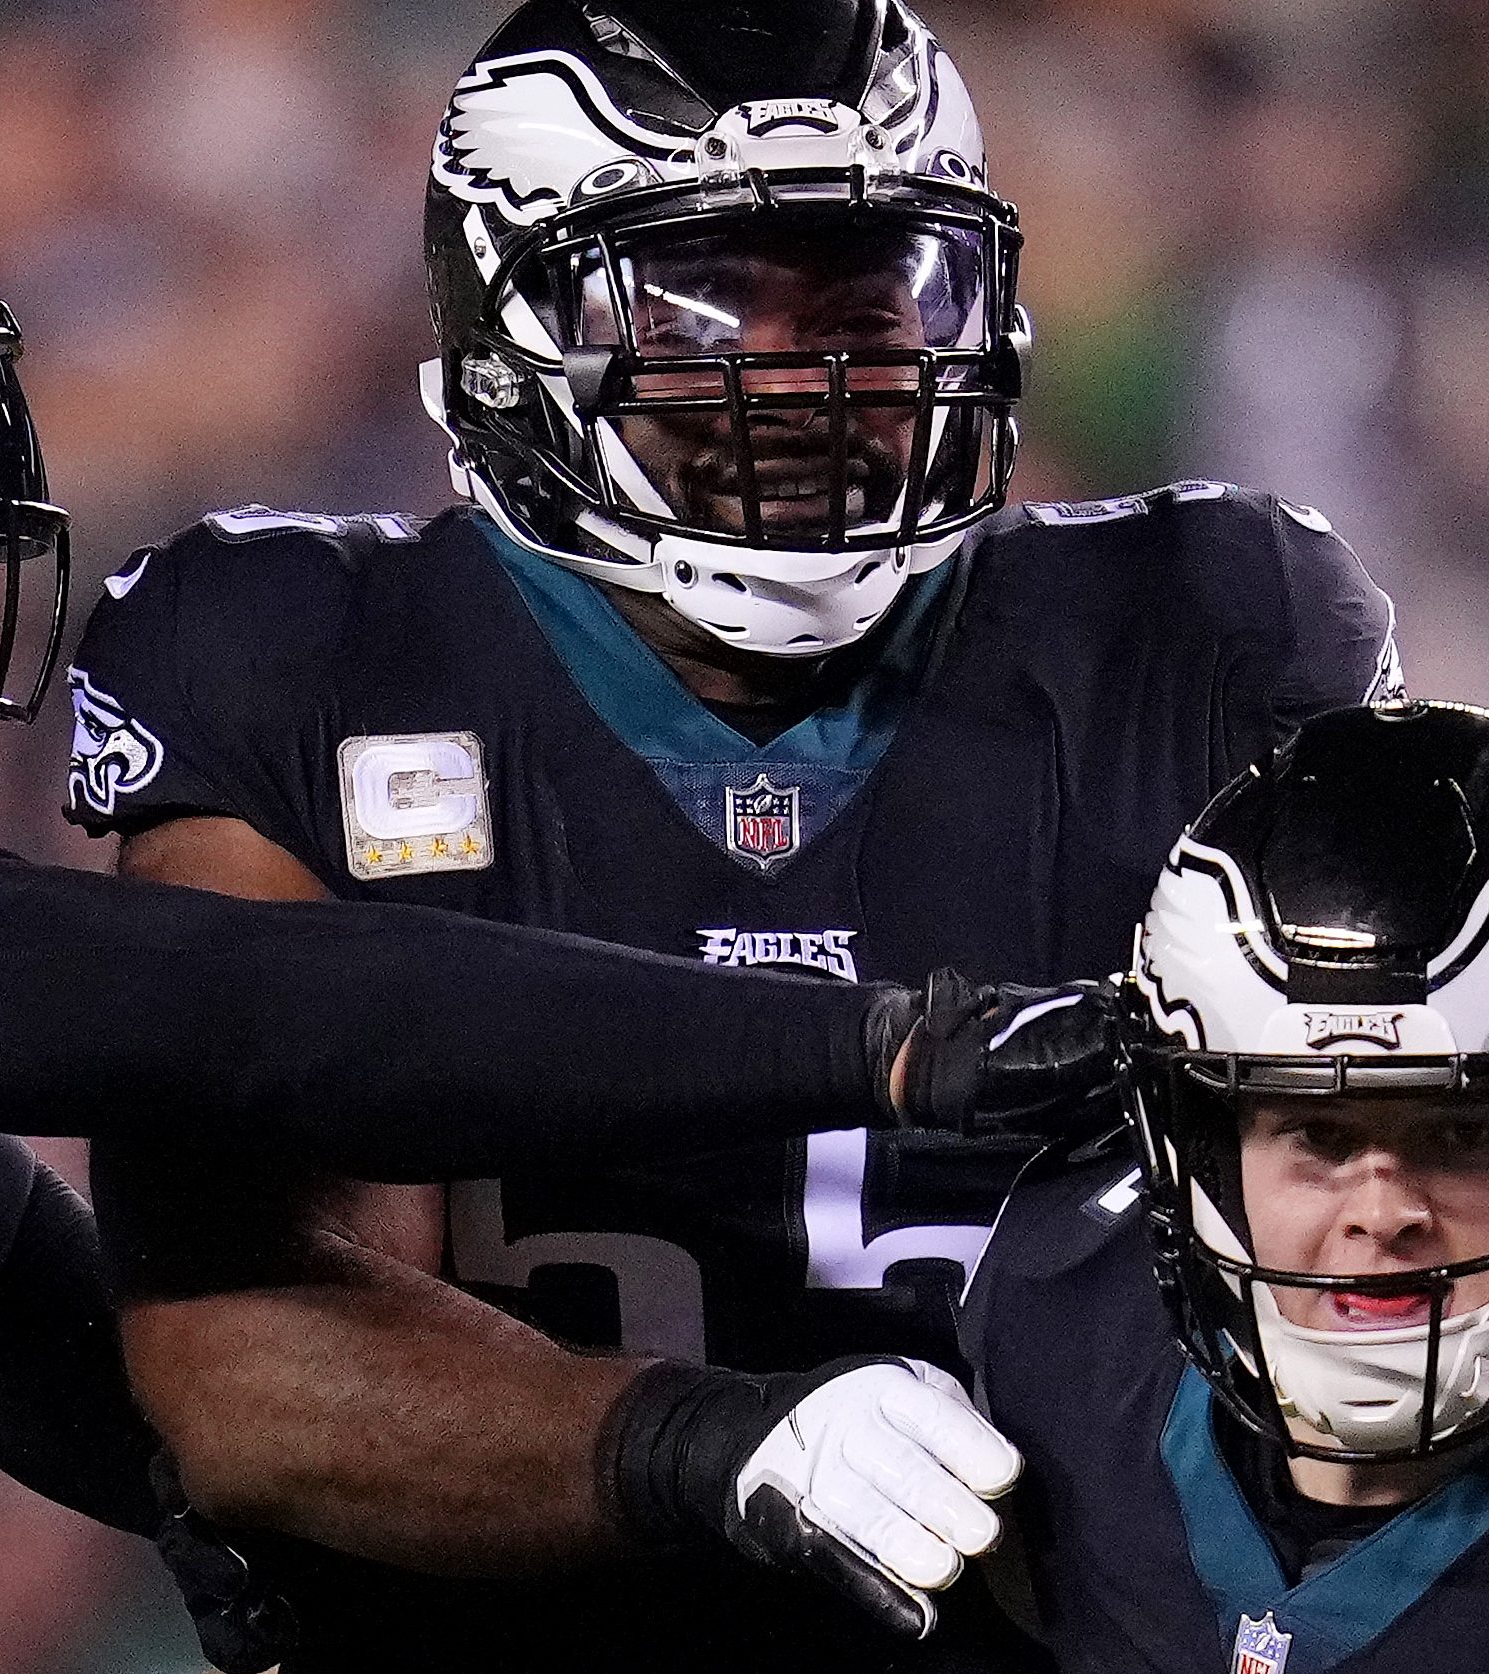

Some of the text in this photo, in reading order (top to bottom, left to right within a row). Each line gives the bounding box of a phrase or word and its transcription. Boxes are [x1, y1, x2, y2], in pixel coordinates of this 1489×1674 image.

[740, 99, 838, 131] EAGLES
[351, 742, 477, 840] C
[740, 817, 787, 850] NFL
[695, 928, 859, 984] EAGLES
